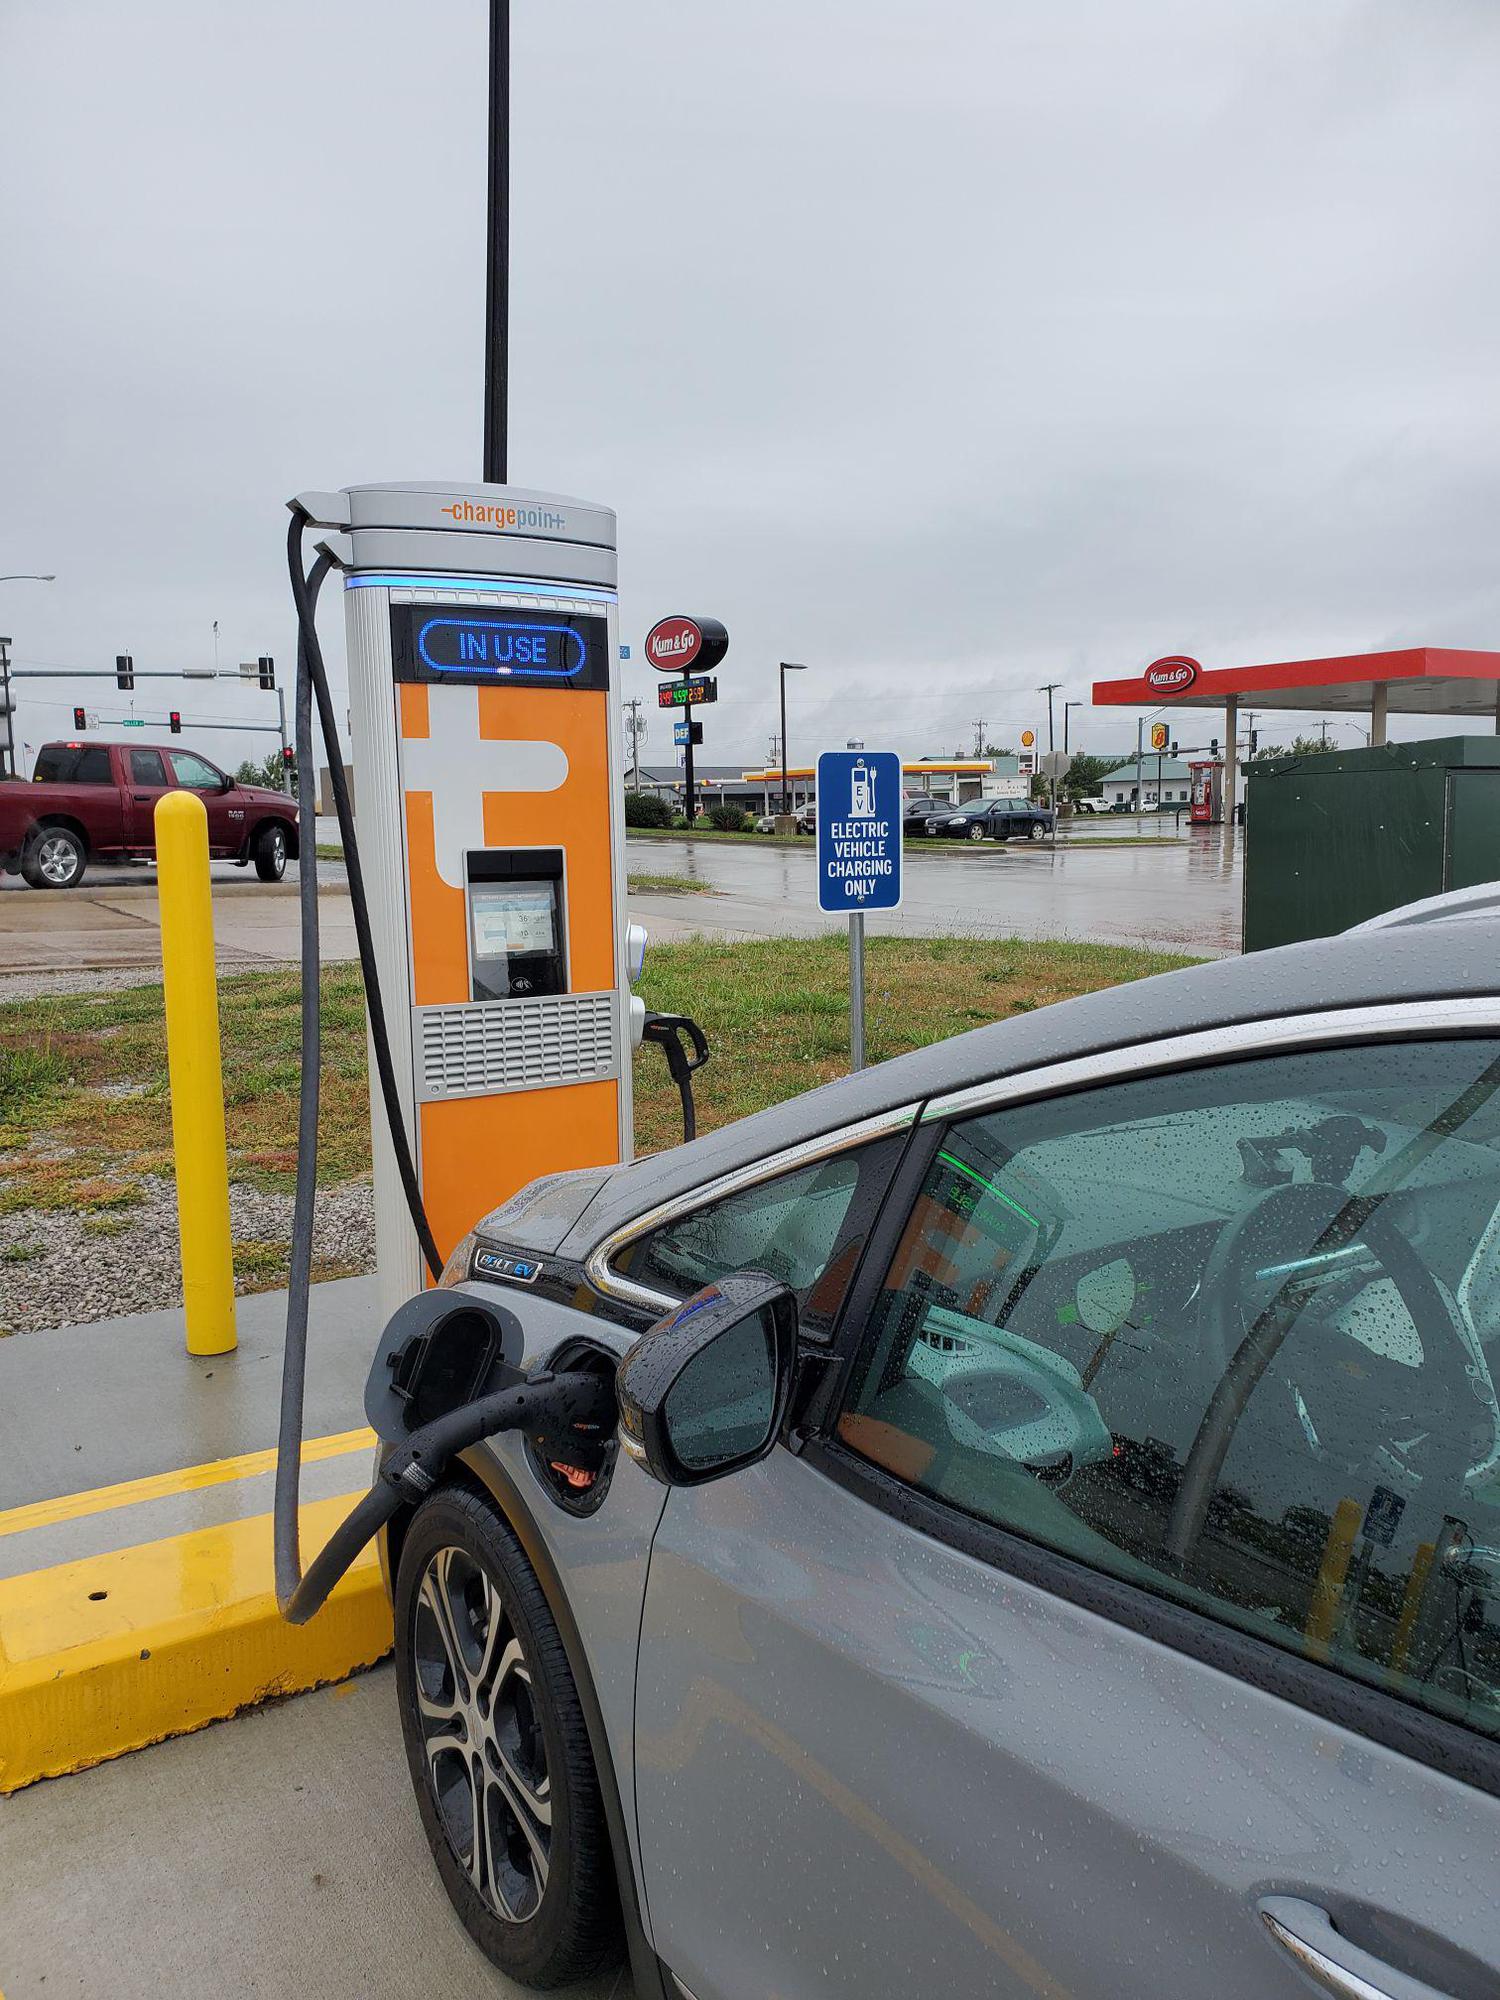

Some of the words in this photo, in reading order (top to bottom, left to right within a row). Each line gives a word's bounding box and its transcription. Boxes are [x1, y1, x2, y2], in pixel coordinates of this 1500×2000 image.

[459, 633, 487, 661] IN
[494, 635, 547, 664] USE
[651, 635, 674, 657] Kum
[681, 629, 695, 652] Go
[1149, 671, 1168, 684] Kum
[1175, 668, 1188, 682] Go
[675, 728, 689, 739] DEF
[831, 821, 889, 839] ELECTRIC
[834, 840, 886, 858] VEHICLE
[827, 859, 892, 878] CHARGING
[844, 879, 877, 897] ONLY
[514, 1263, 534, 1277] EV
